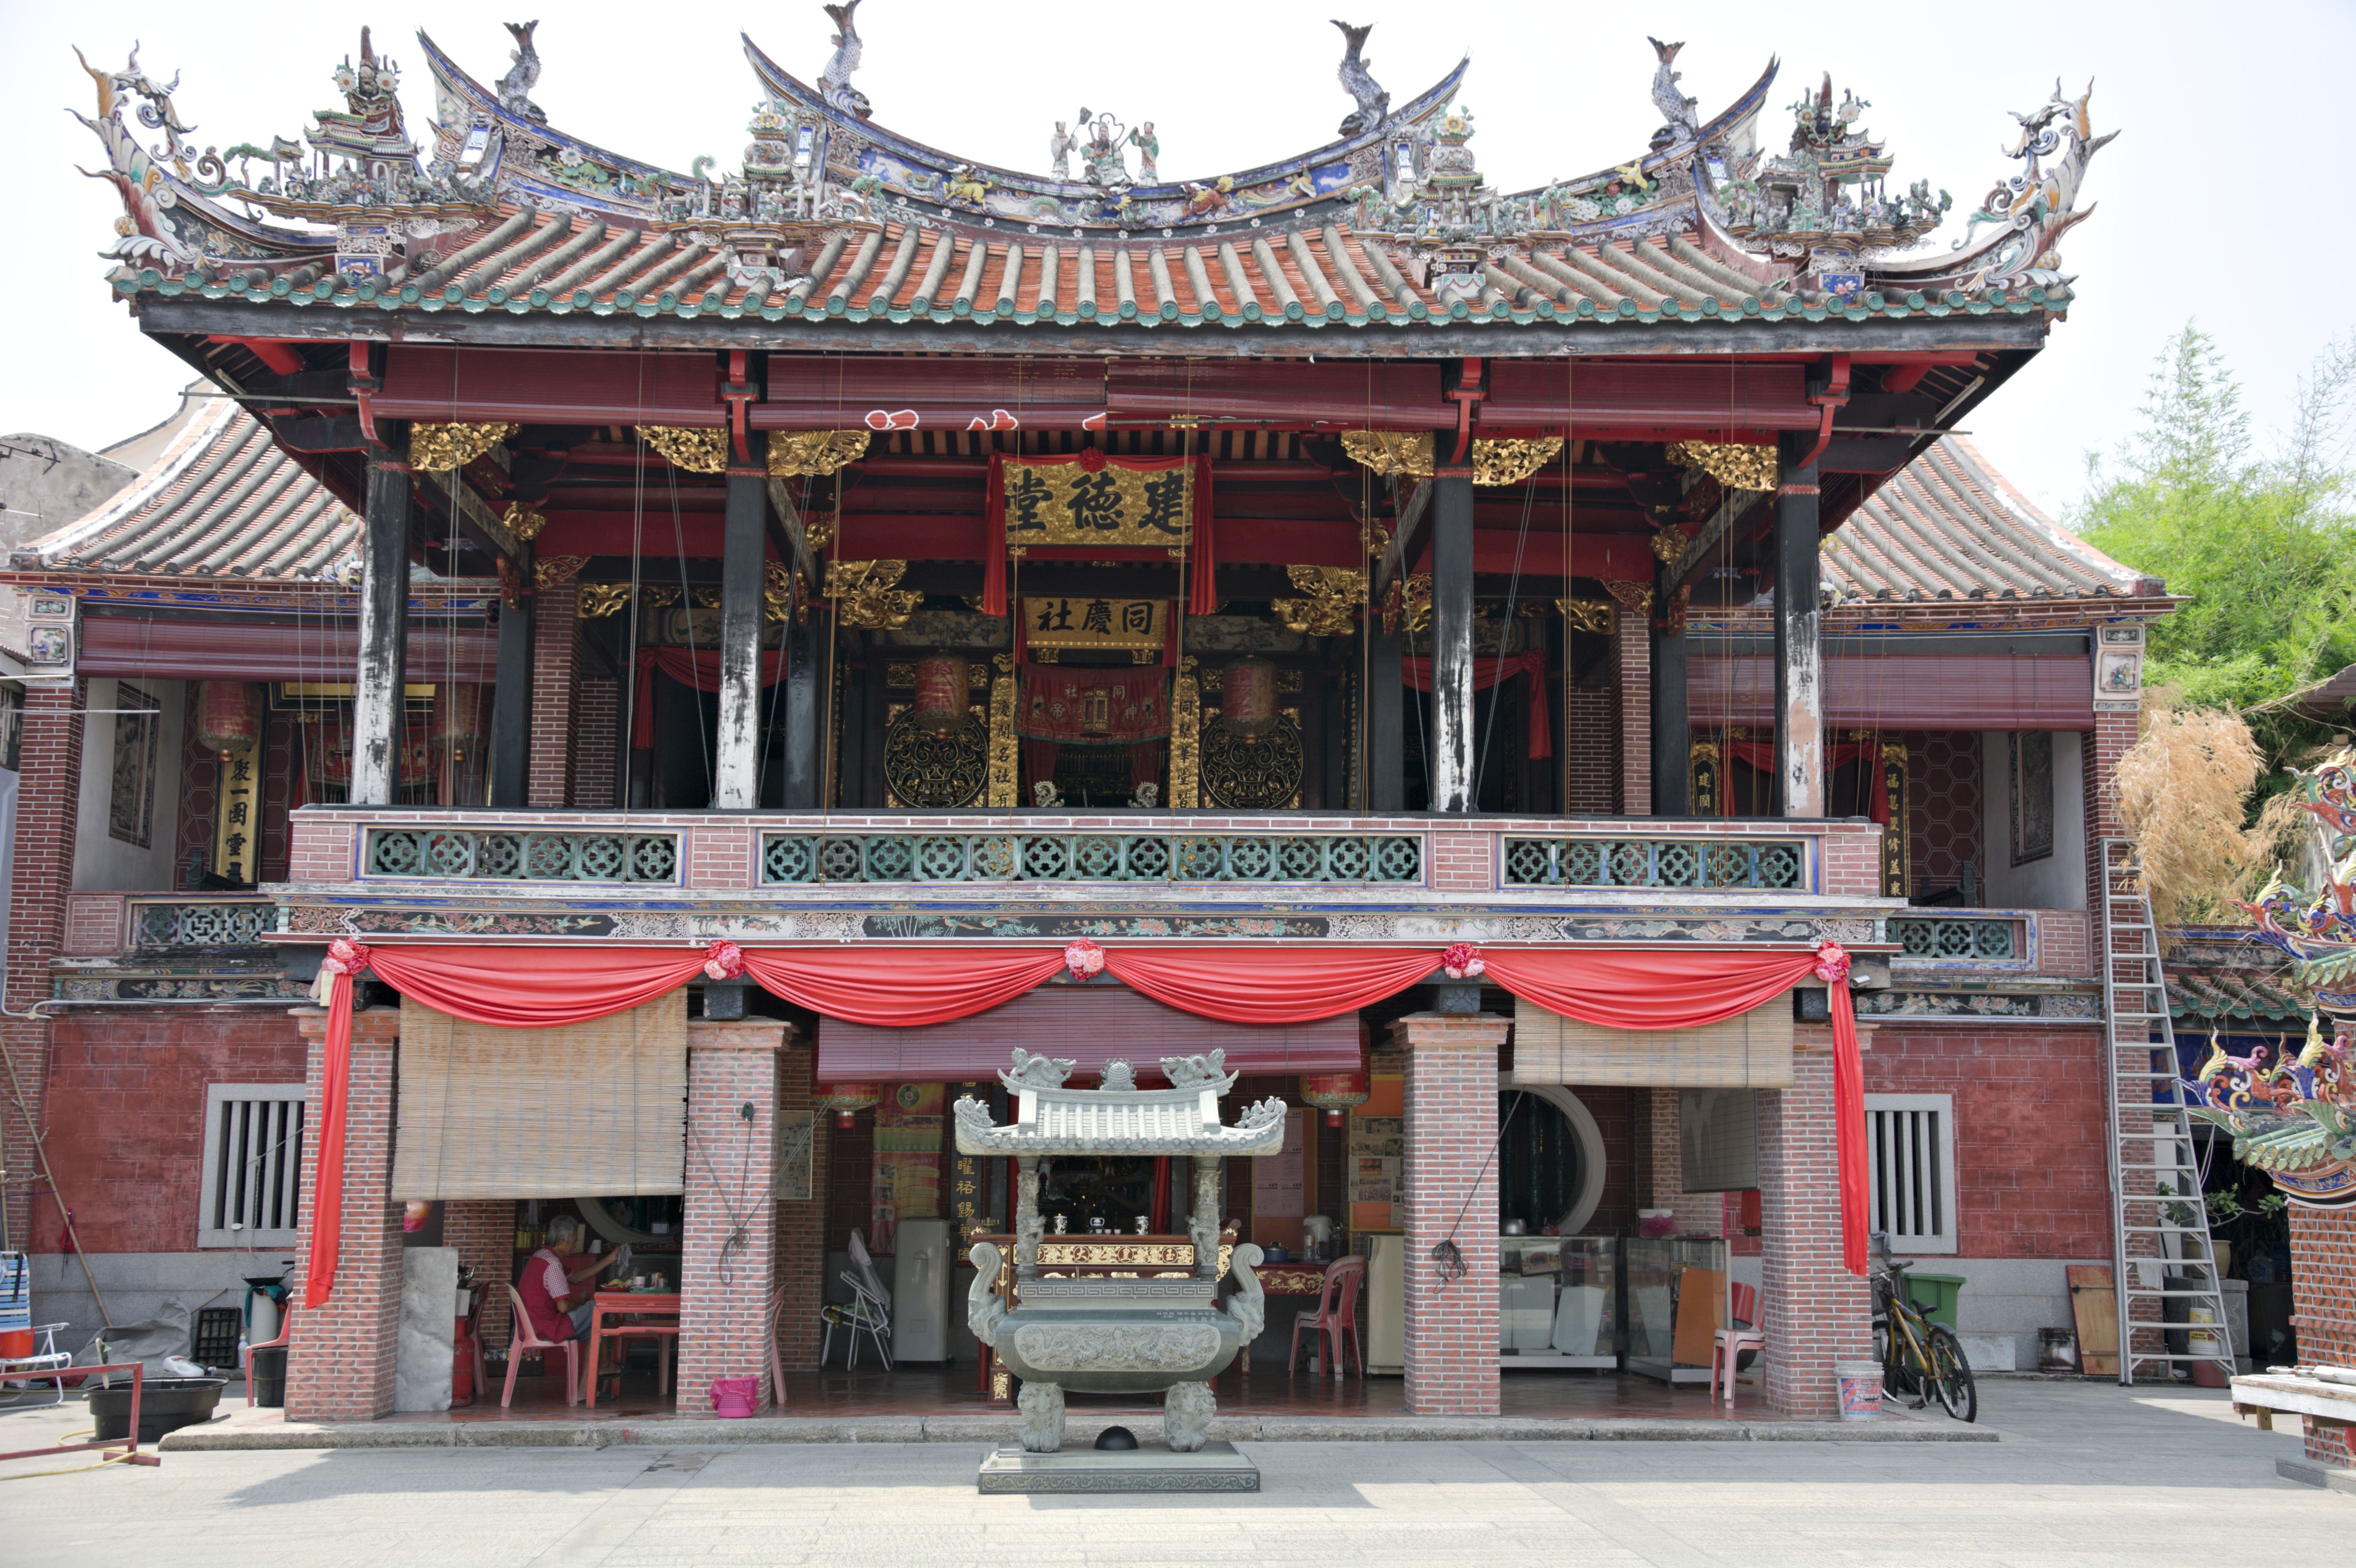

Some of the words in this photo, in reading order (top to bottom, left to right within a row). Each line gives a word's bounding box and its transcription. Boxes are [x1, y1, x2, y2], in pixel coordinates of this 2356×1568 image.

[1005, 468, 1192, 535] 建德堂
[1037, 599, 1154, 635] 同慶社
[1063, 683, 1125, 700] 同社
[226, 751, 251, 856] 聚一團靈
